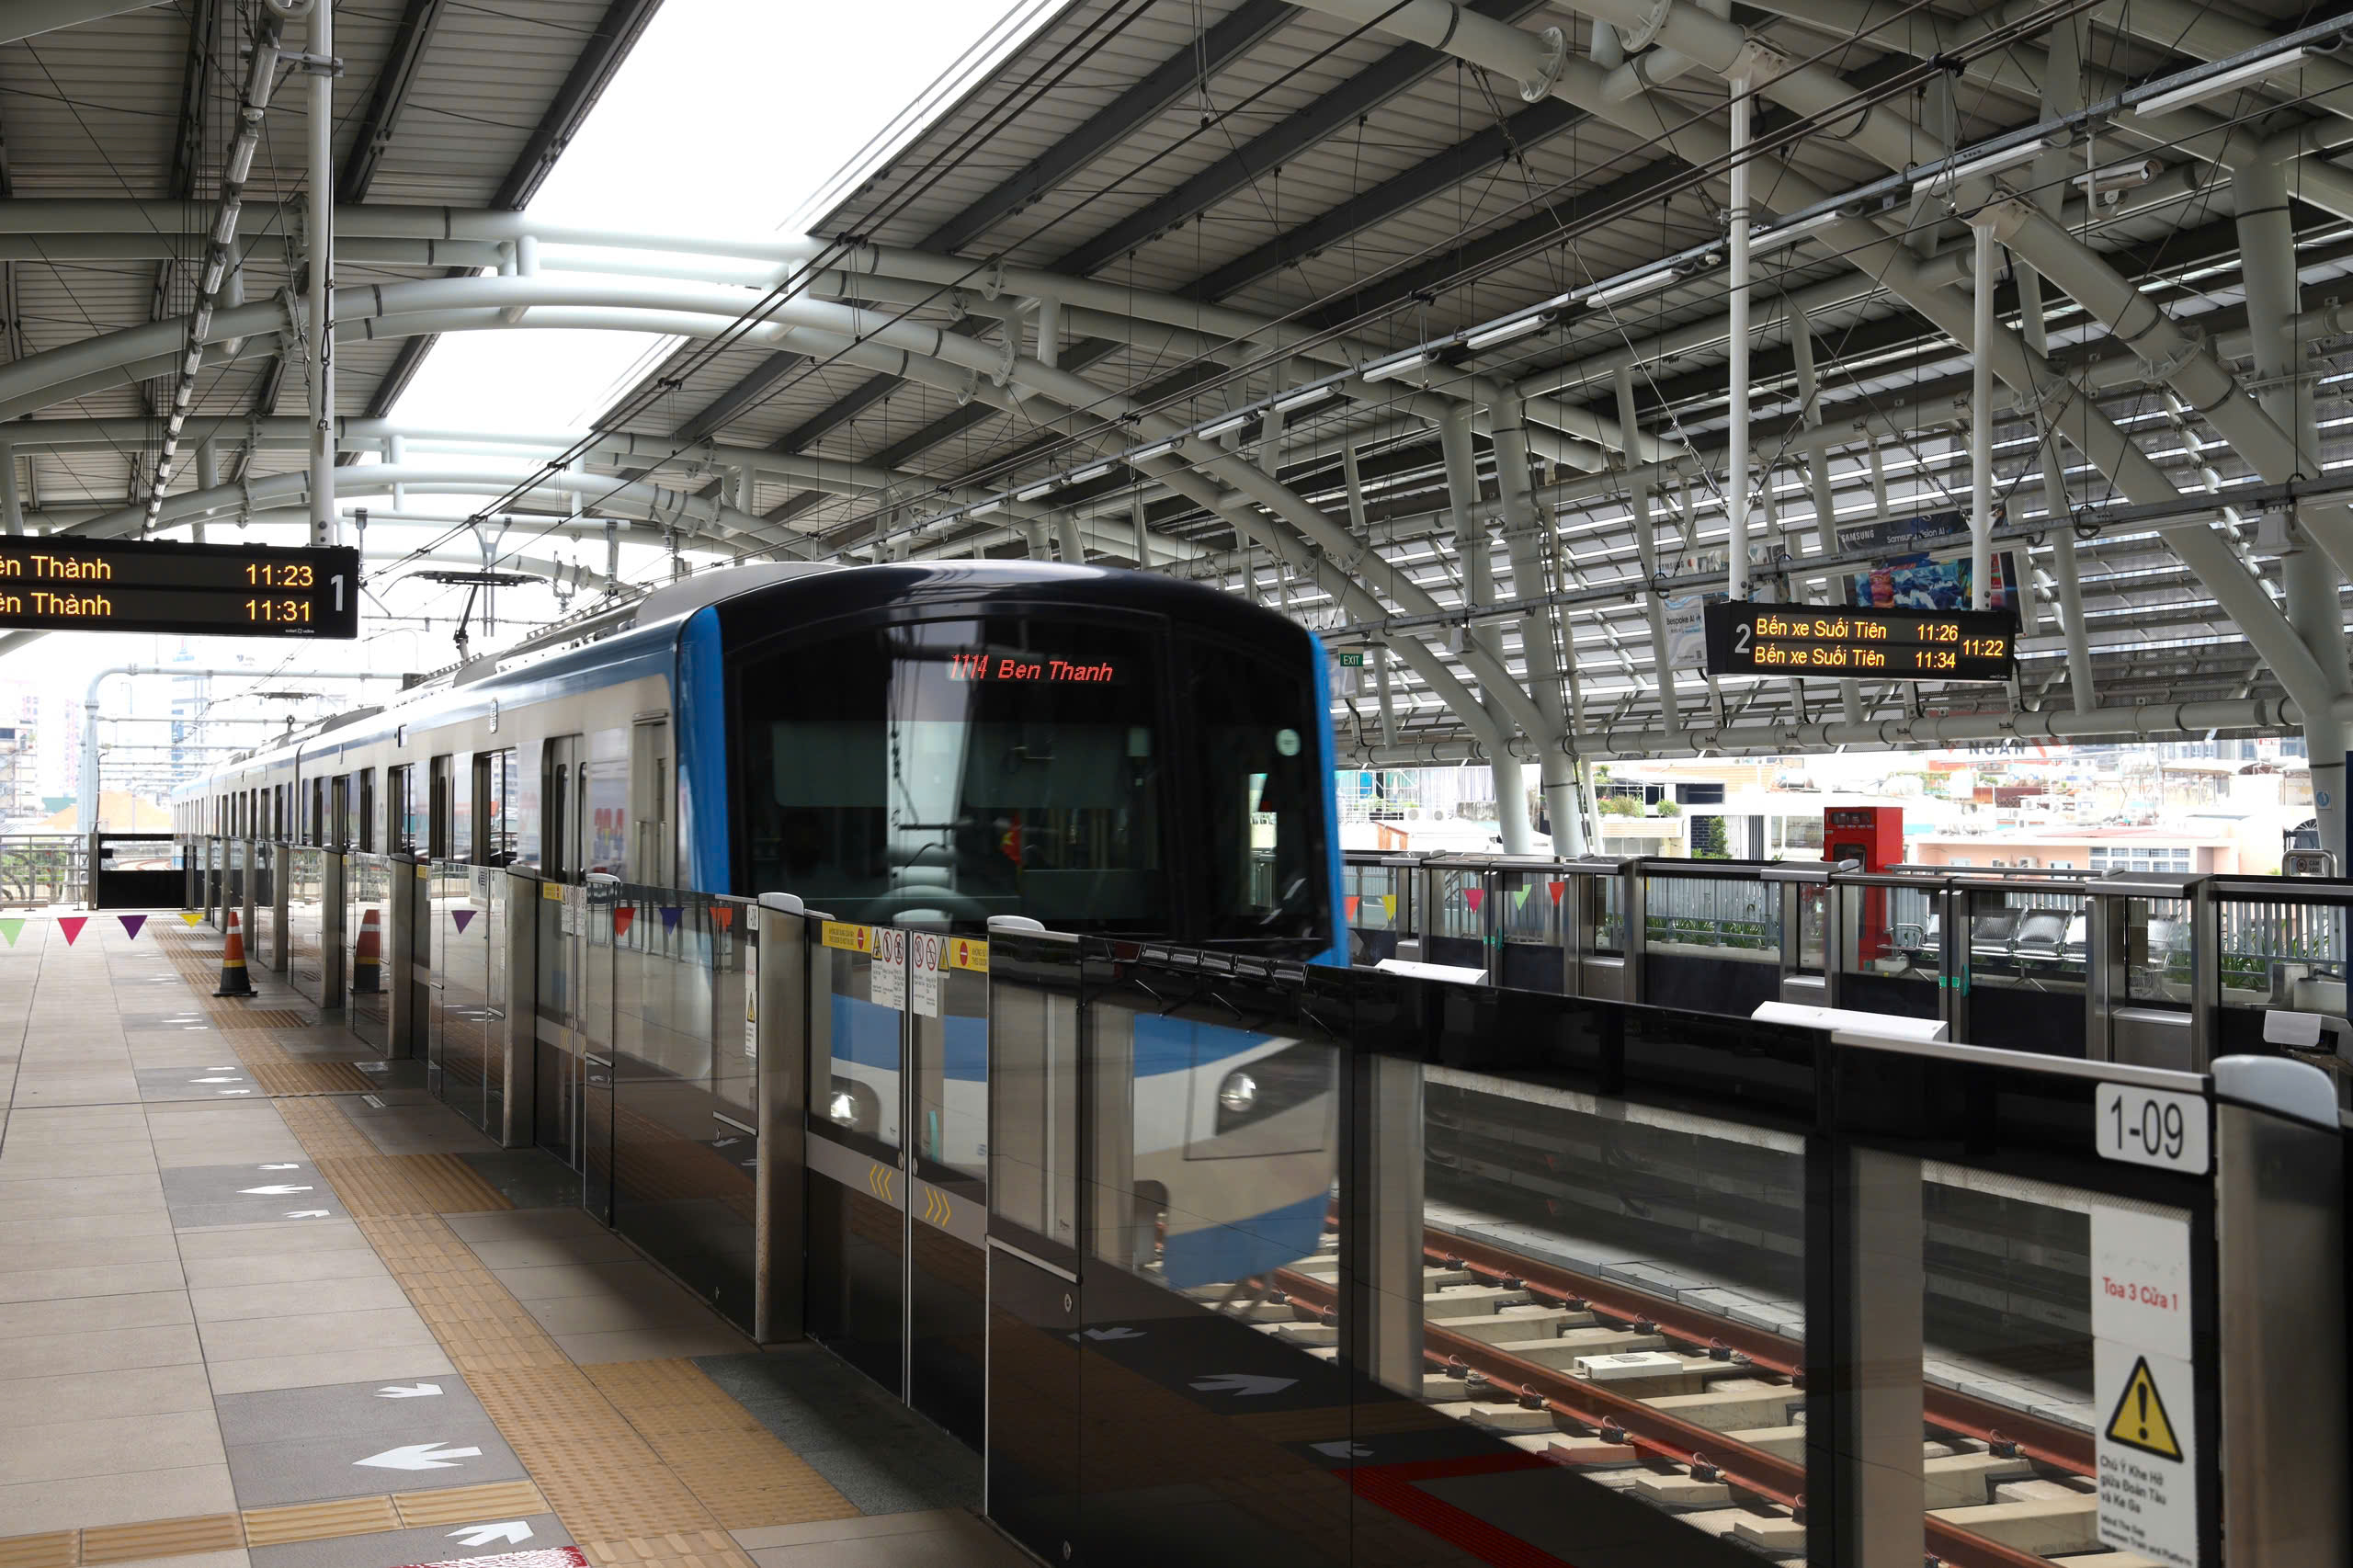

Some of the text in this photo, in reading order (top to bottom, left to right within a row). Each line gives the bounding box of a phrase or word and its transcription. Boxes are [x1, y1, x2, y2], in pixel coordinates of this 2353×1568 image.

[1841, 529, 1874, 542] SAMSUNG
[30, 555, 111, 579] Thành
[246, 563, 313, 586] 11:23
[30, 592, 111, 616] Thành
[331, 574, 344, 611] 1
[245, 599, 310, 622] 11:31
[1665, 616, 1688, 626] Bespoke
[1734, 623, 1751, 653] 2
[1756, 615, 1887, 639] Bến xe Suối Tiên
[1917, 624, 1959, 642] 11:26
[1755, 643, 1885, 666] Bến xe Suối Tiên
[1962, 639, 2004, 656] 11:22
[950, 653, 1113, 682] 1114 Ben Thanh
[1343, 655, 1359, 665] EXIT
[1915, 651, 1956, 668] 11:34
[2111, 1095, 2183, 1159] 1-09
[2102, 1276, 2125, 1299] Toa
[2128, 1282, 2137, 1301] 3
[2172, 1293, 2177, 1312] 1
